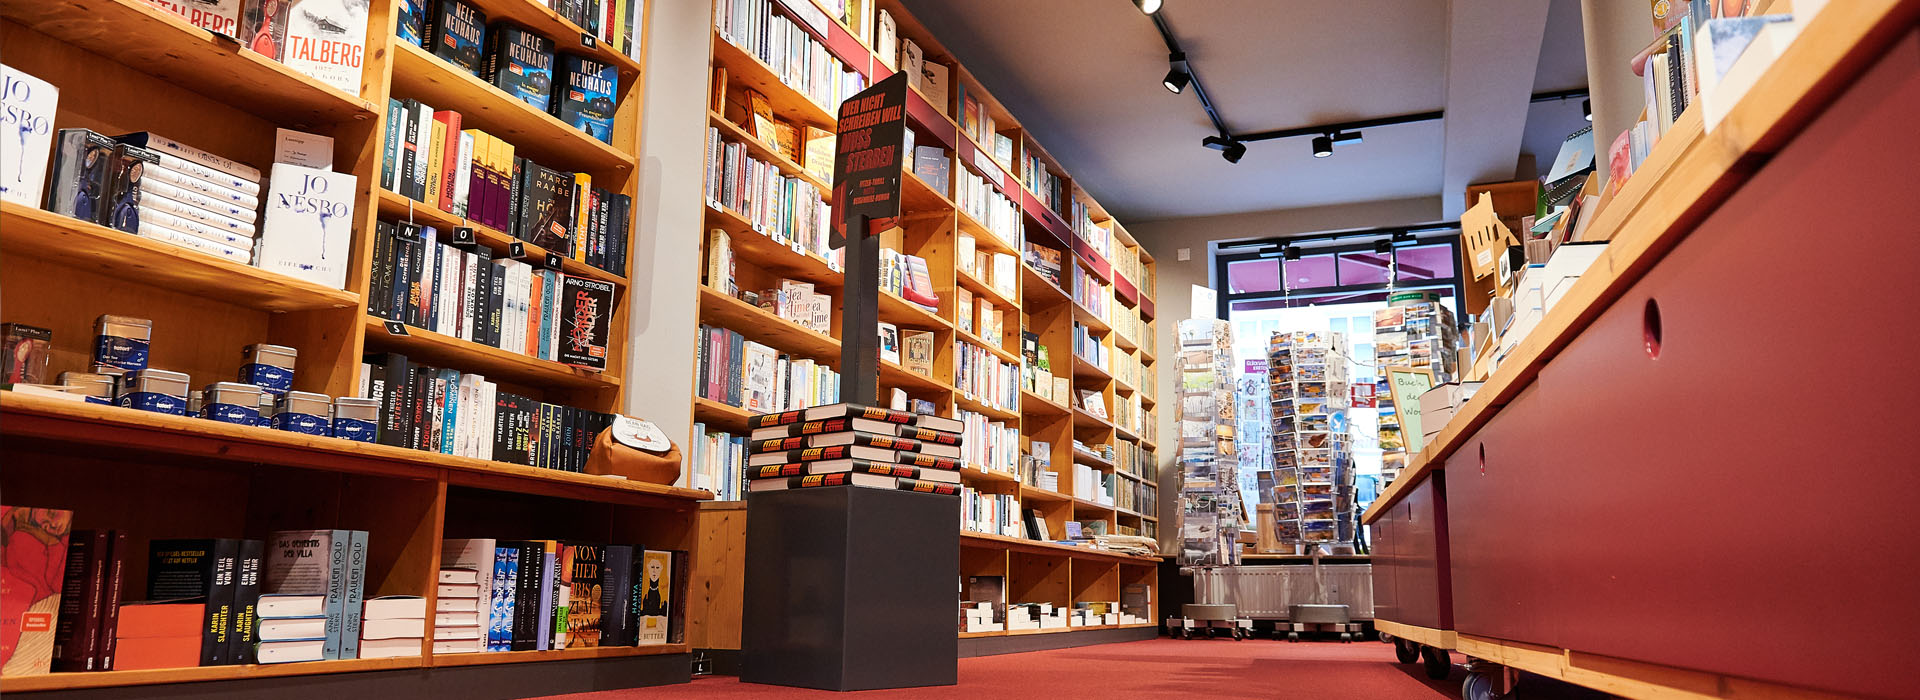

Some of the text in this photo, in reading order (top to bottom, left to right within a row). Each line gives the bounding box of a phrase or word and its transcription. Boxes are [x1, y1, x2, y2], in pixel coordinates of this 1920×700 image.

[456, 2, 476, 26] NELE
[445, 12, 480, 46] NEUHAUS
[290, 35, 362, 68] TALBERG
[520, 31, 542, 52] NELE
[585, 37, 593, 46] M
[510, 42, 549, 71] NEUHAUS
[582, 60, 604, 79] NELE
[2, 76, 31, 102] JO
[570, 72, 612, 96] NEUHAUS
[842, 93, 886, 117] WER NICHT
[838, 104, 902, 134] SCHREIBEN WILL
[840, 128, 872, 154] MUSS
[846, 145, 895, 174] STERBEN
[298, 174, 328, 195] JO
[536, 180, 570, 197] RAABE
[540, 172, 568, 186] MARC
[404, 226, 414, 237] N
[460, 230, 467, 240] O
[578, 225, 586, 252] KATHY
[514, 246, 520, 254] P
[550, 258, 557, 266] R
[566, 278, 611, 292] ARNO STROBEL
[786, 288, 802, 304] Tea
[786, 302, 810, 318] time
[394, 324, 400, 333] S
[570, 290, 588, 352] MÖRDER
[1398, 378, 1424, 388] Buch
[448, 375, 457, 414] TUOMINEN
[279, 540, 290, 548] DAS
[284, 549, 312, 558] DER VILLA
[333, 542, 342, 565] GOLD
[352, 542, 362, 565] GOLD
[574, 546, 598, 560] VON
[216, 558, 226, 586] EIN TEIL
[224, 557, 234, 586] VON IHR
[243, 558, 251, 572] TEIL
[248, 558, 259, 586] VON IHR
[572, 563, 598, 578] HIER
[494, 568, 506, 633] ALLES SPRICHT
[505, 568, 517, 633] ALLES SPRICHT
[574, 582, 591, 598] BIS
[210, 613, 220, 634] KARIN
[218, 605, 229, 643] SLAUGHTER
[236, 612, 245, 633] KARIN
[242, 604, 254, 642] SLAUGHTER
